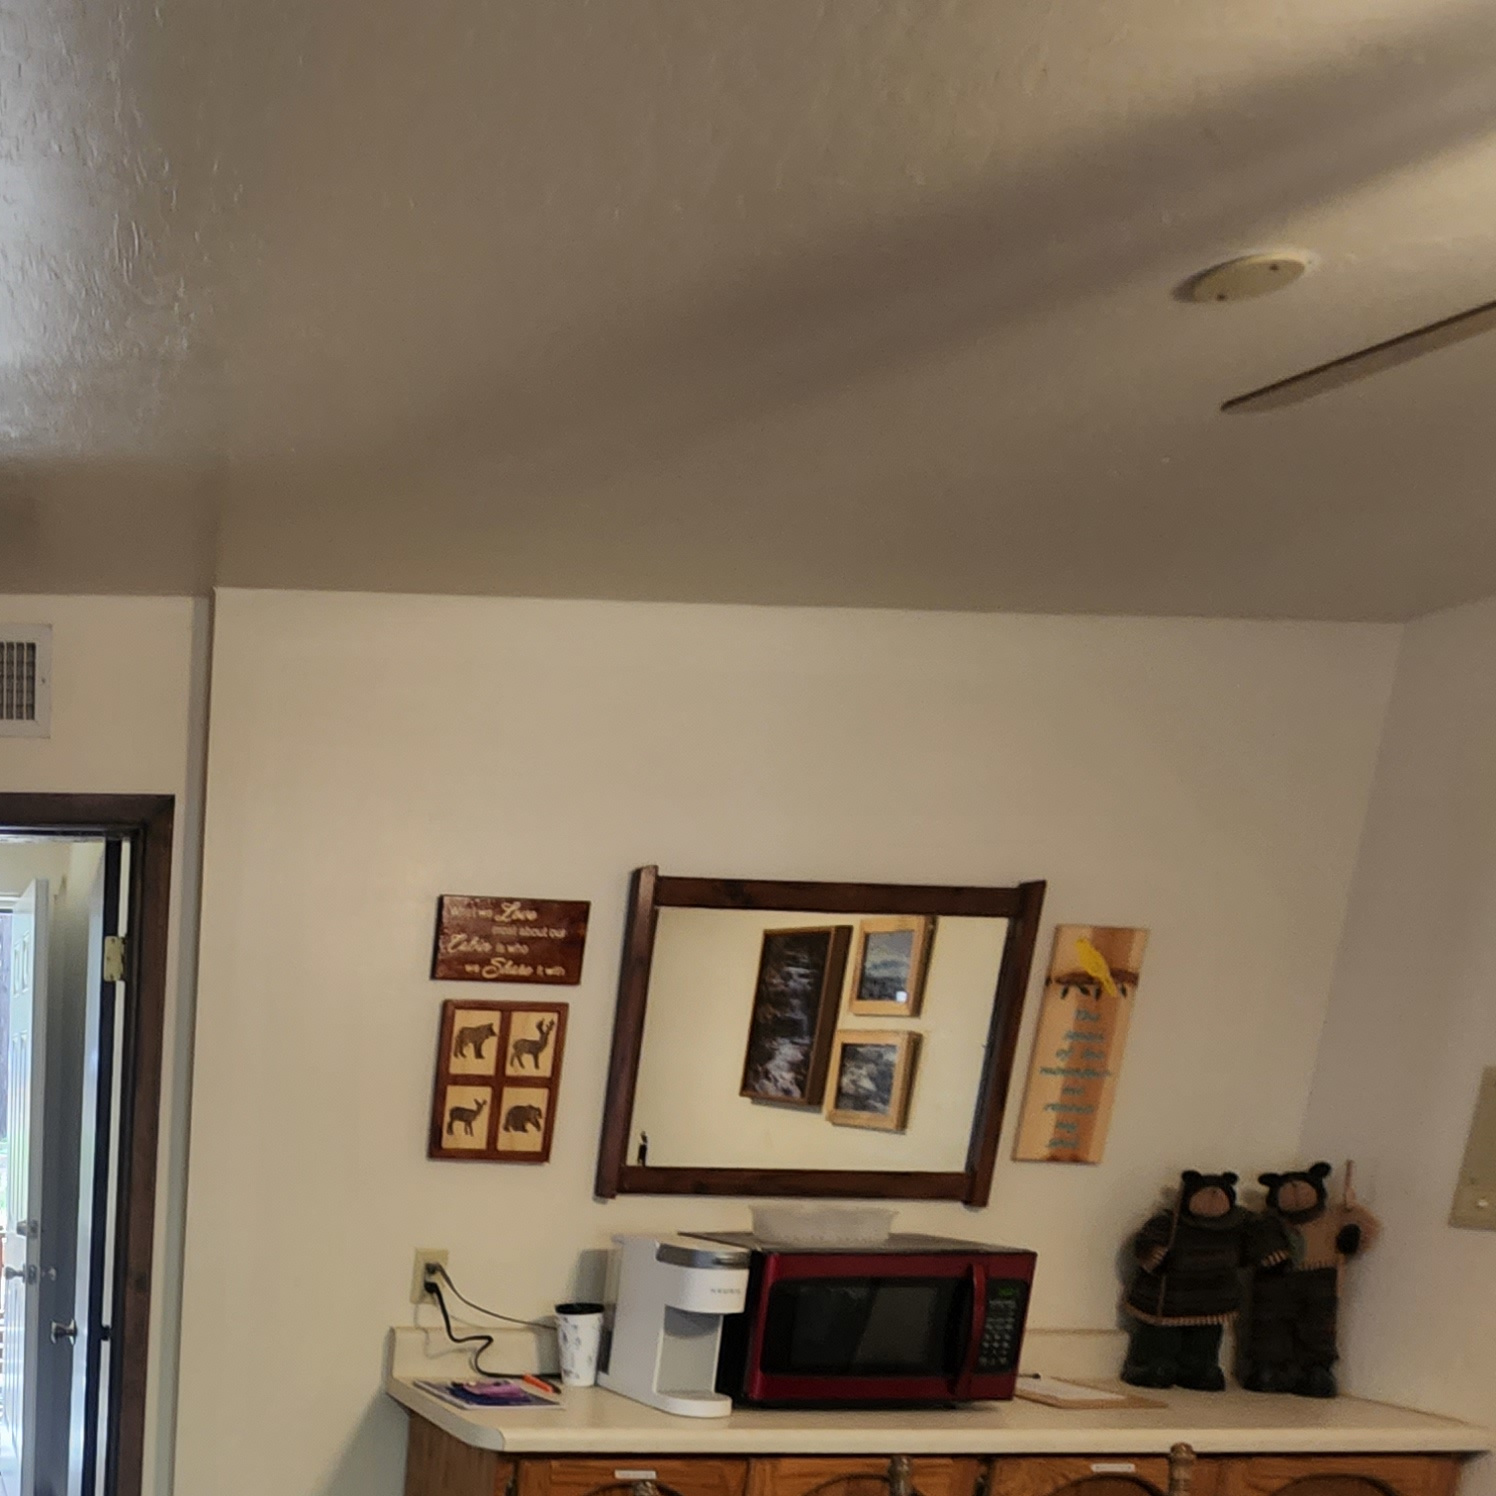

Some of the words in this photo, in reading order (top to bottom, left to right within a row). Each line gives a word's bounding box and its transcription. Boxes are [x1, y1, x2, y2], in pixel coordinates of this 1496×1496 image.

[493, 901, 537, 922] Love
[519, 925, 548, 938] about
[482, 957, 534, 979] Share
